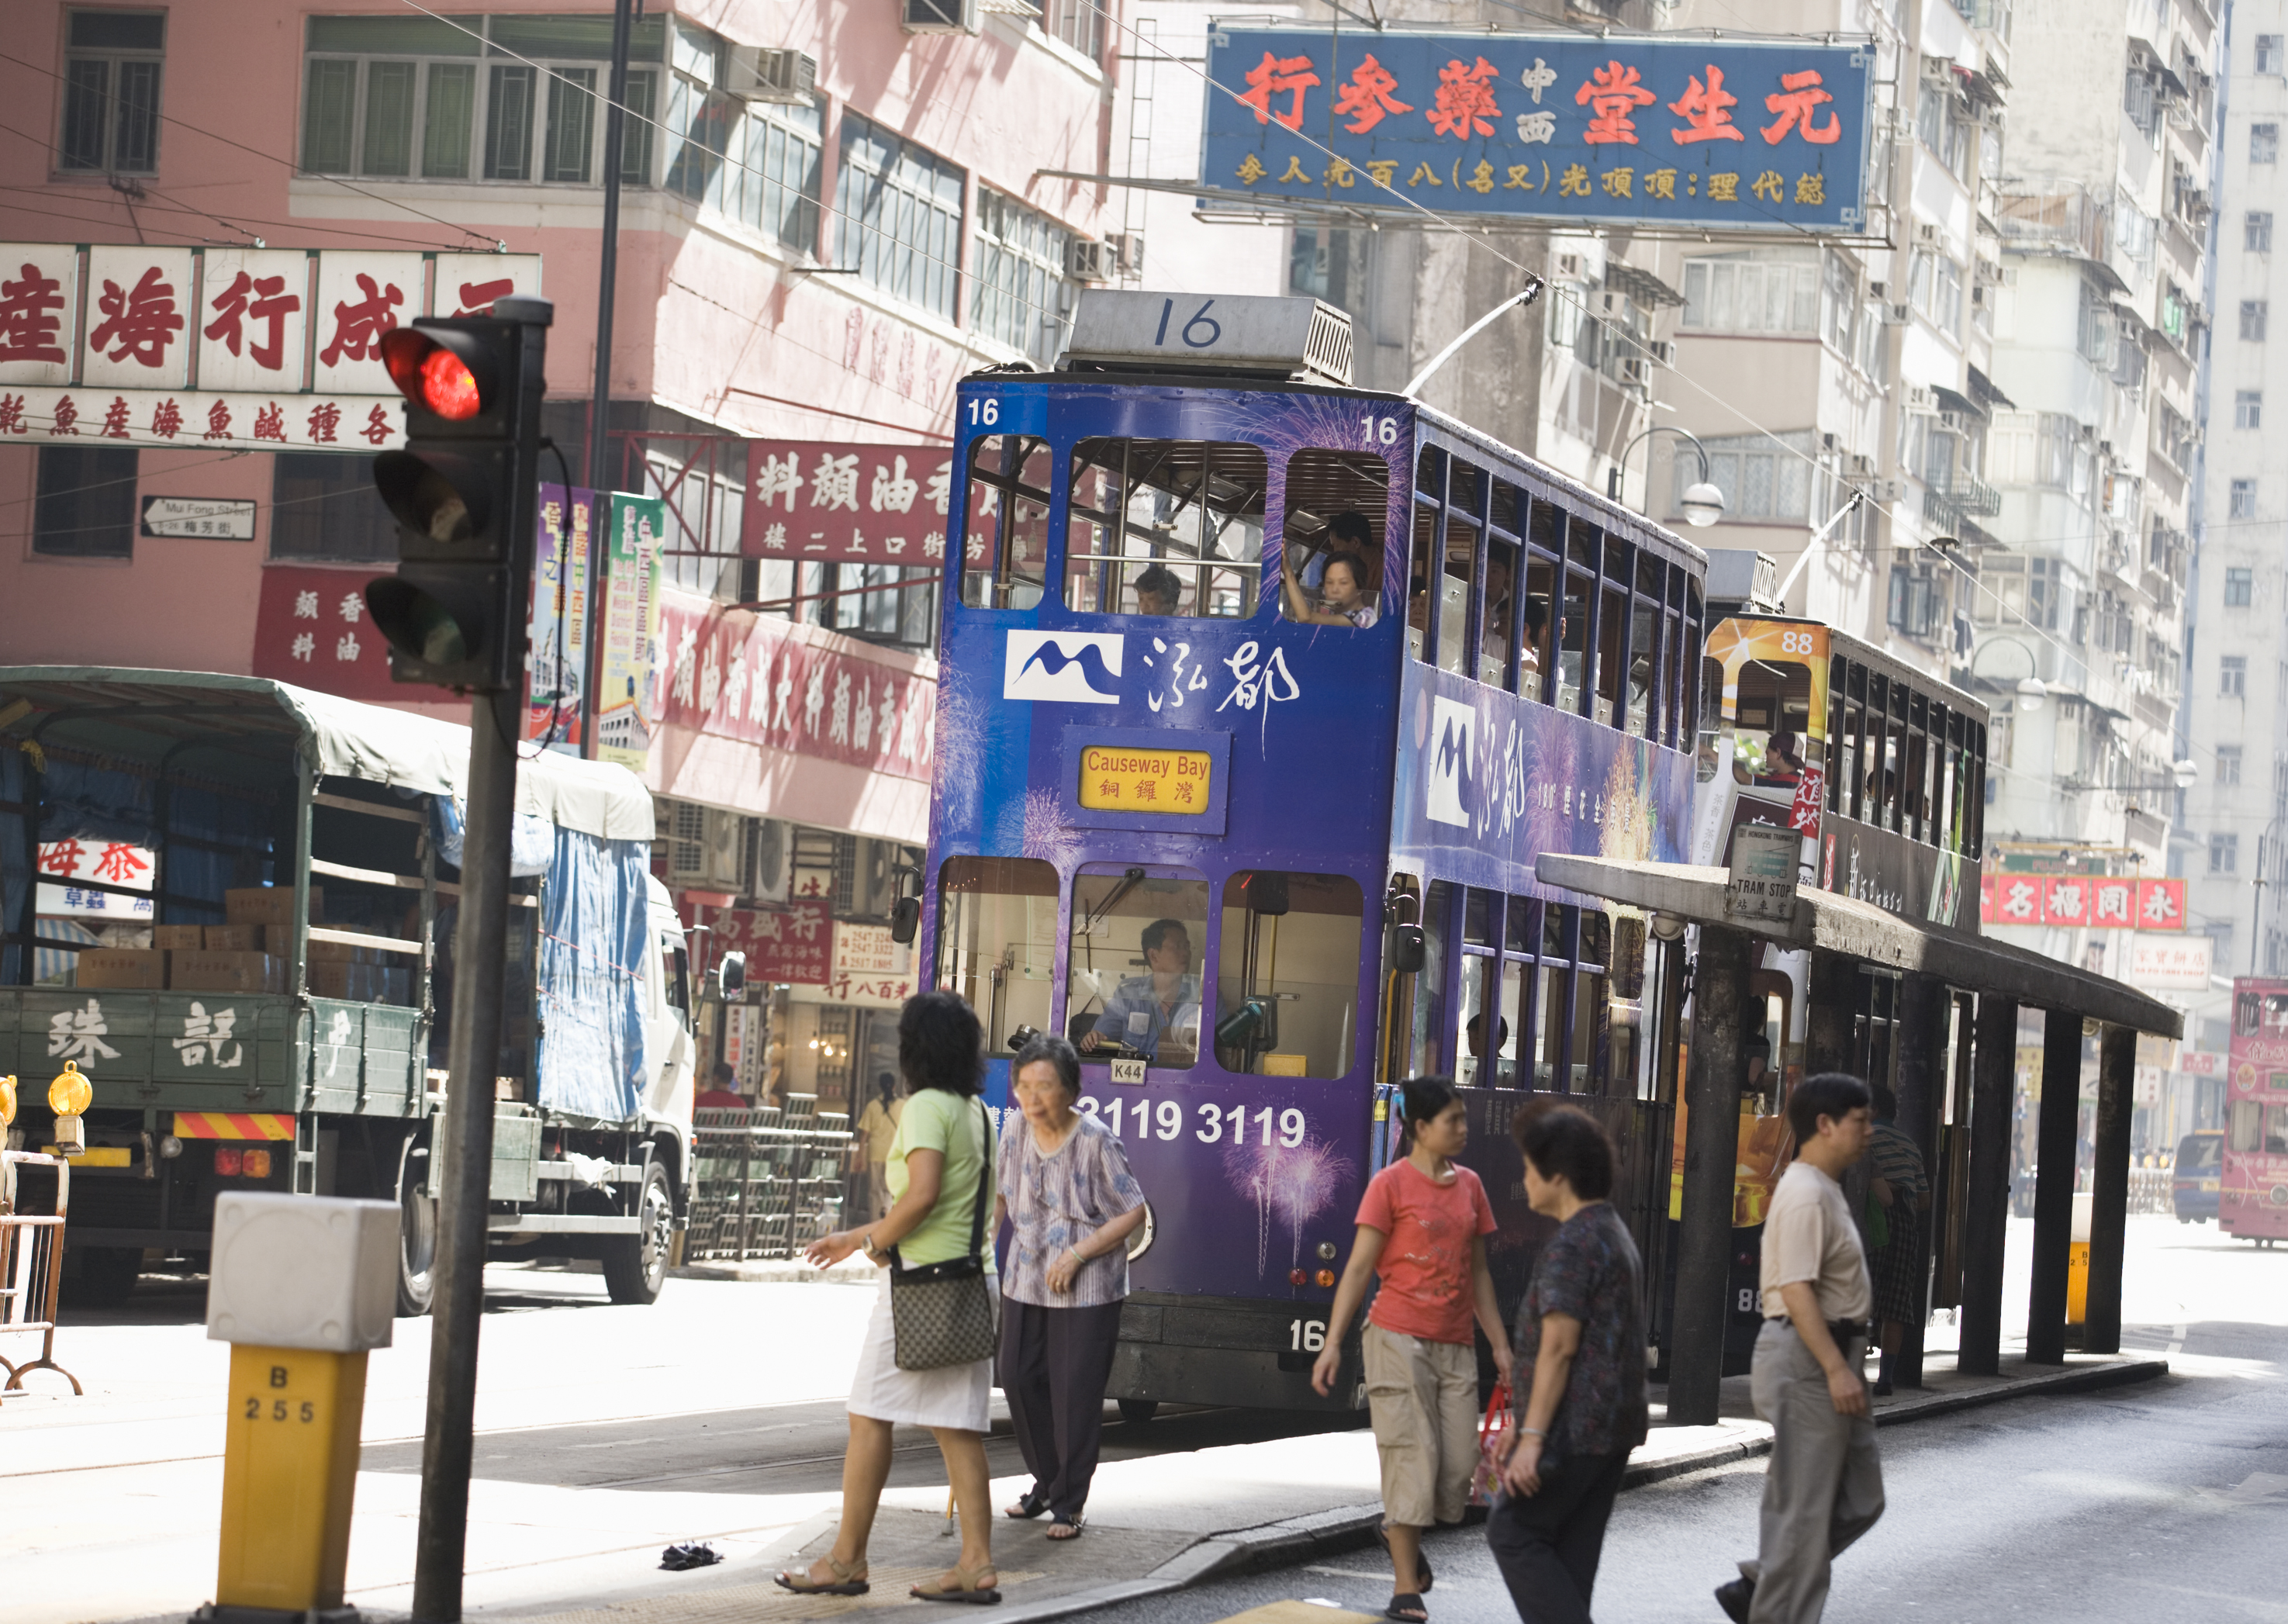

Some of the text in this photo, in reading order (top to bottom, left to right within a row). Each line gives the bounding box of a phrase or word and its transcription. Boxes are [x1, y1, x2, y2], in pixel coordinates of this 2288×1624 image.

[1155, 299, 1222, 348] 16
[967, 398, 999, 426] 16
[1360, 416, 1398, 445] 16
[165, 503, 185, 513] Mui
[188, 503, 215, 515] Fong
[1781, 631, 1813, 655] 88
[1087, 749, 1209, 779] Causeway Bay
[1098, 778, 1195, 805] 銅鑼灣
[1737, 879, 1792, 898] TRAM STOP
[1115, 1063, 1142, 1082] K44
[1077, 1096, 1306, 1149] 3119 3119
[1291, 1320, 1325, 1353] 16
[269, 1367, 288, 1388] B
